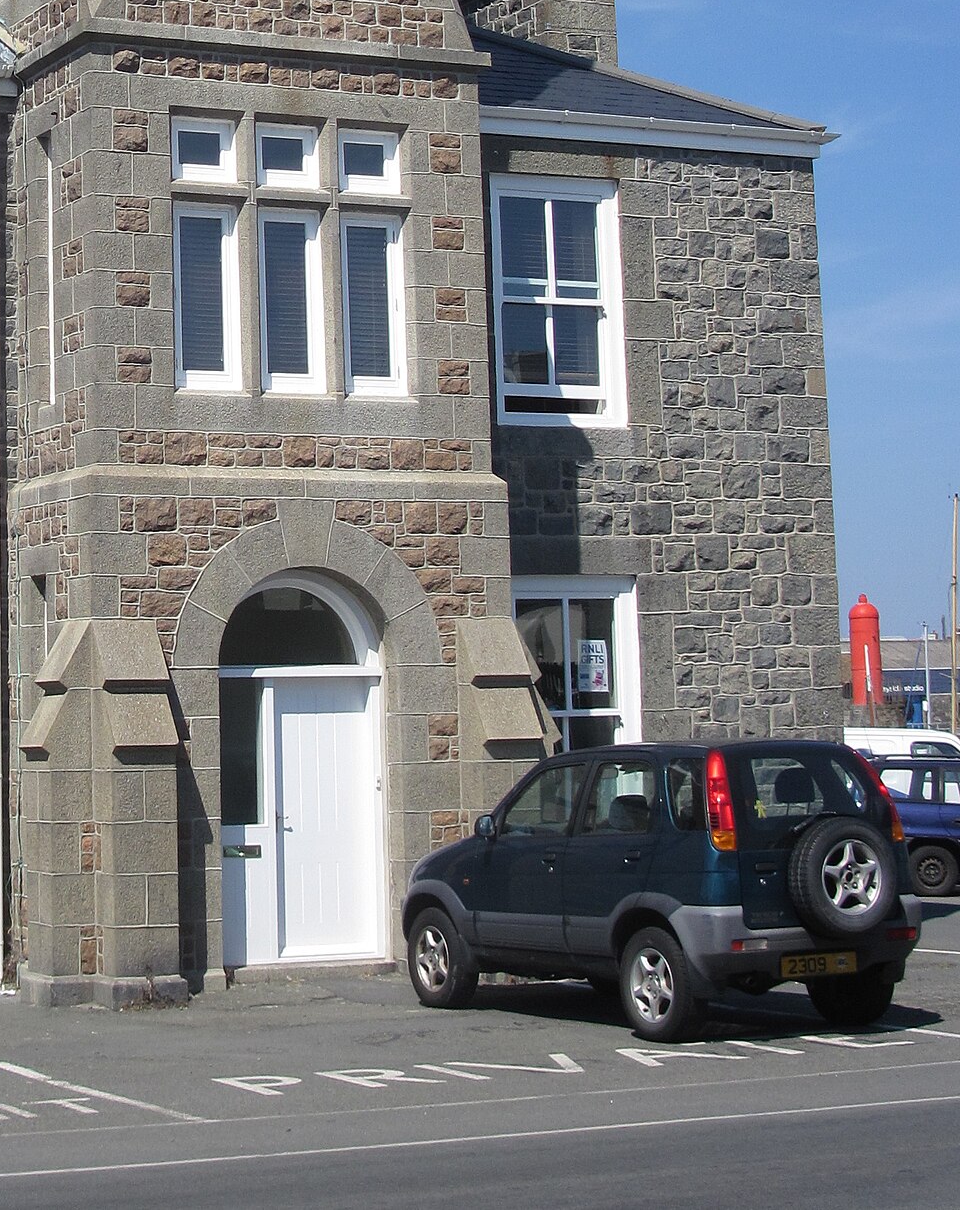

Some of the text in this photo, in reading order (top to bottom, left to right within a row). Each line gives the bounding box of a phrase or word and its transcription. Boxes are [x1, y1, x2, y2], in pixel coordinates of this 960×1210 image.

[581, 644, 604, 654] RNLI
[581, 655, 605, 664] GIFTS
[788, 956, 827, 975] 2309
